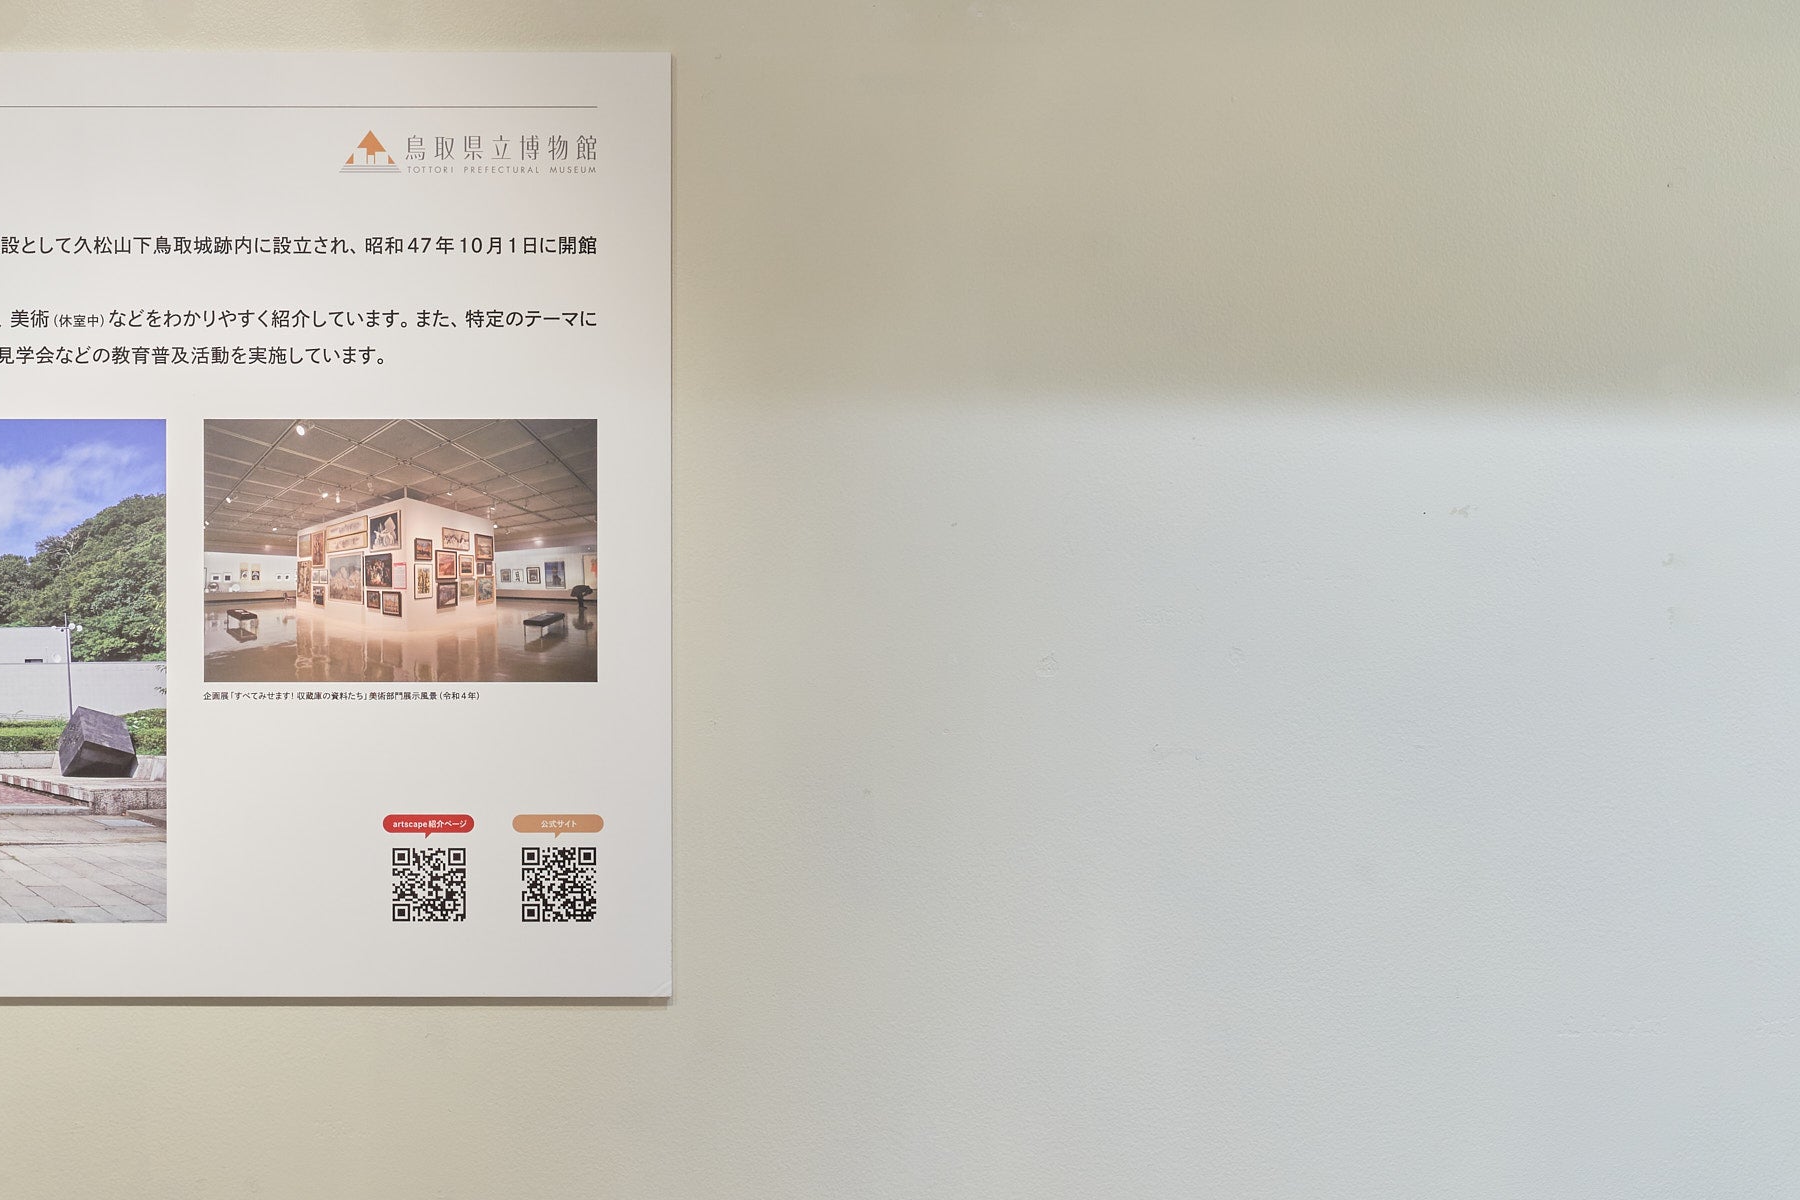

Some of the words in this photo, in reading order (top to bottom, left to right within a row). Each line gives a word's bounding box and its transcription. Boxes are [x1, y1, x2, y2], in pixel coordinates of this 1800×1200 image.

[406, 135, 596, 160] 鳥取県立博物館
[541, 819, 577, 828] 公式サイト
